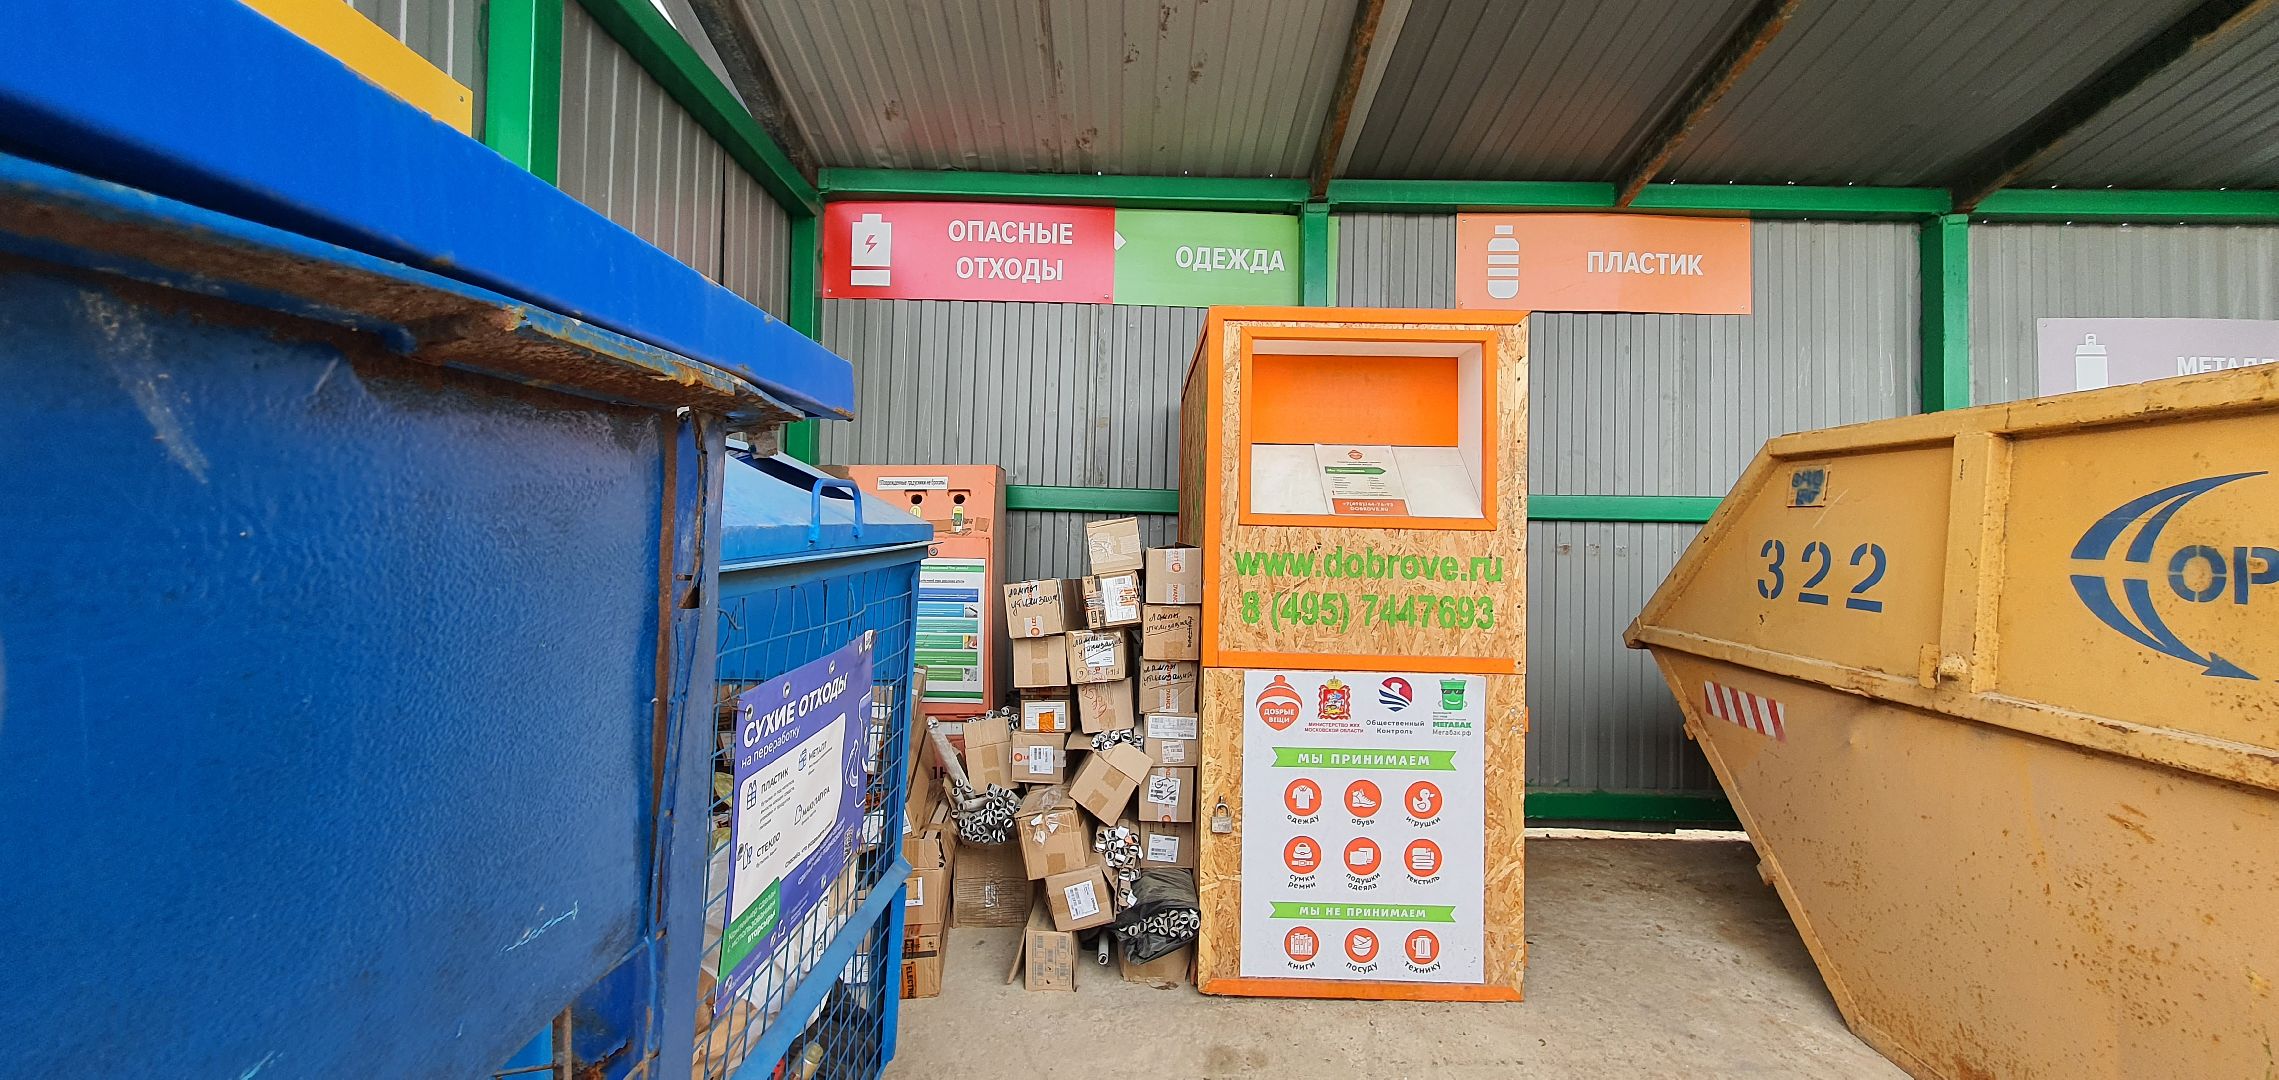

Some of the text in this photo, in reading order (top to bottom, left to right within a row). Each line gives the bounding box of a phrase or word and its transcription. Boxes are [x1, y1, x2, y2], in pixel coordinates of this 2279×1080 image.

[948, 219, 1074, 246] ОПАСНЫЕ
[1175, 245, 1286, 274] ОДЕЖДА
[1586, 251, 1704, 276] ПЛАСТИК
[956, 256, 1064, 283] ОТХОДЫ
[1234, 545, 1503, 582] www.dobrove.ru
[1757, 539, 1887, 613] 322
[1241, 591, 1496, 634] 8 (495) 7447693
[743, 672, 849, 748] СУХИЕ ОТХОДЫ
[1263, 708, 1295, 716] ДОБРЫЕ
[1365, 719, 1425, 727] Общественный
[1432, 721, 1472, 729] МЕГАБАК
[741, 755, 752, 769] на
[753, 725, 801, 762] переработку
[1297, 753, 1430, 766] МЫ ПРИНИМАЕМ
[761, 767, 789, 794] ПЛАСТИК
[1286, 814, 1320, 825] одежду
[1350, 817, 1375, 828] обувь
[1405, 816, 1442, 828] игрушки
[756, 831, 781, 858] СТЕКЛО
[1289, 873, 1316, 883] сумки
[1346, 872, 1381, 885] подушки
[1405, 873, 1441, 885] текстиль
[1287, 881, 1317, 890] ремни
[1347, 882, 1378, 891] одеяла
[1299, 906, 1427, 918] МЫ НЕ ПРИНИМАЕМ
[1287, 960, 1316, 971] книги
[1346, 960, 1379, 975] посуду
[1405, 960, 1442, 974] технику
